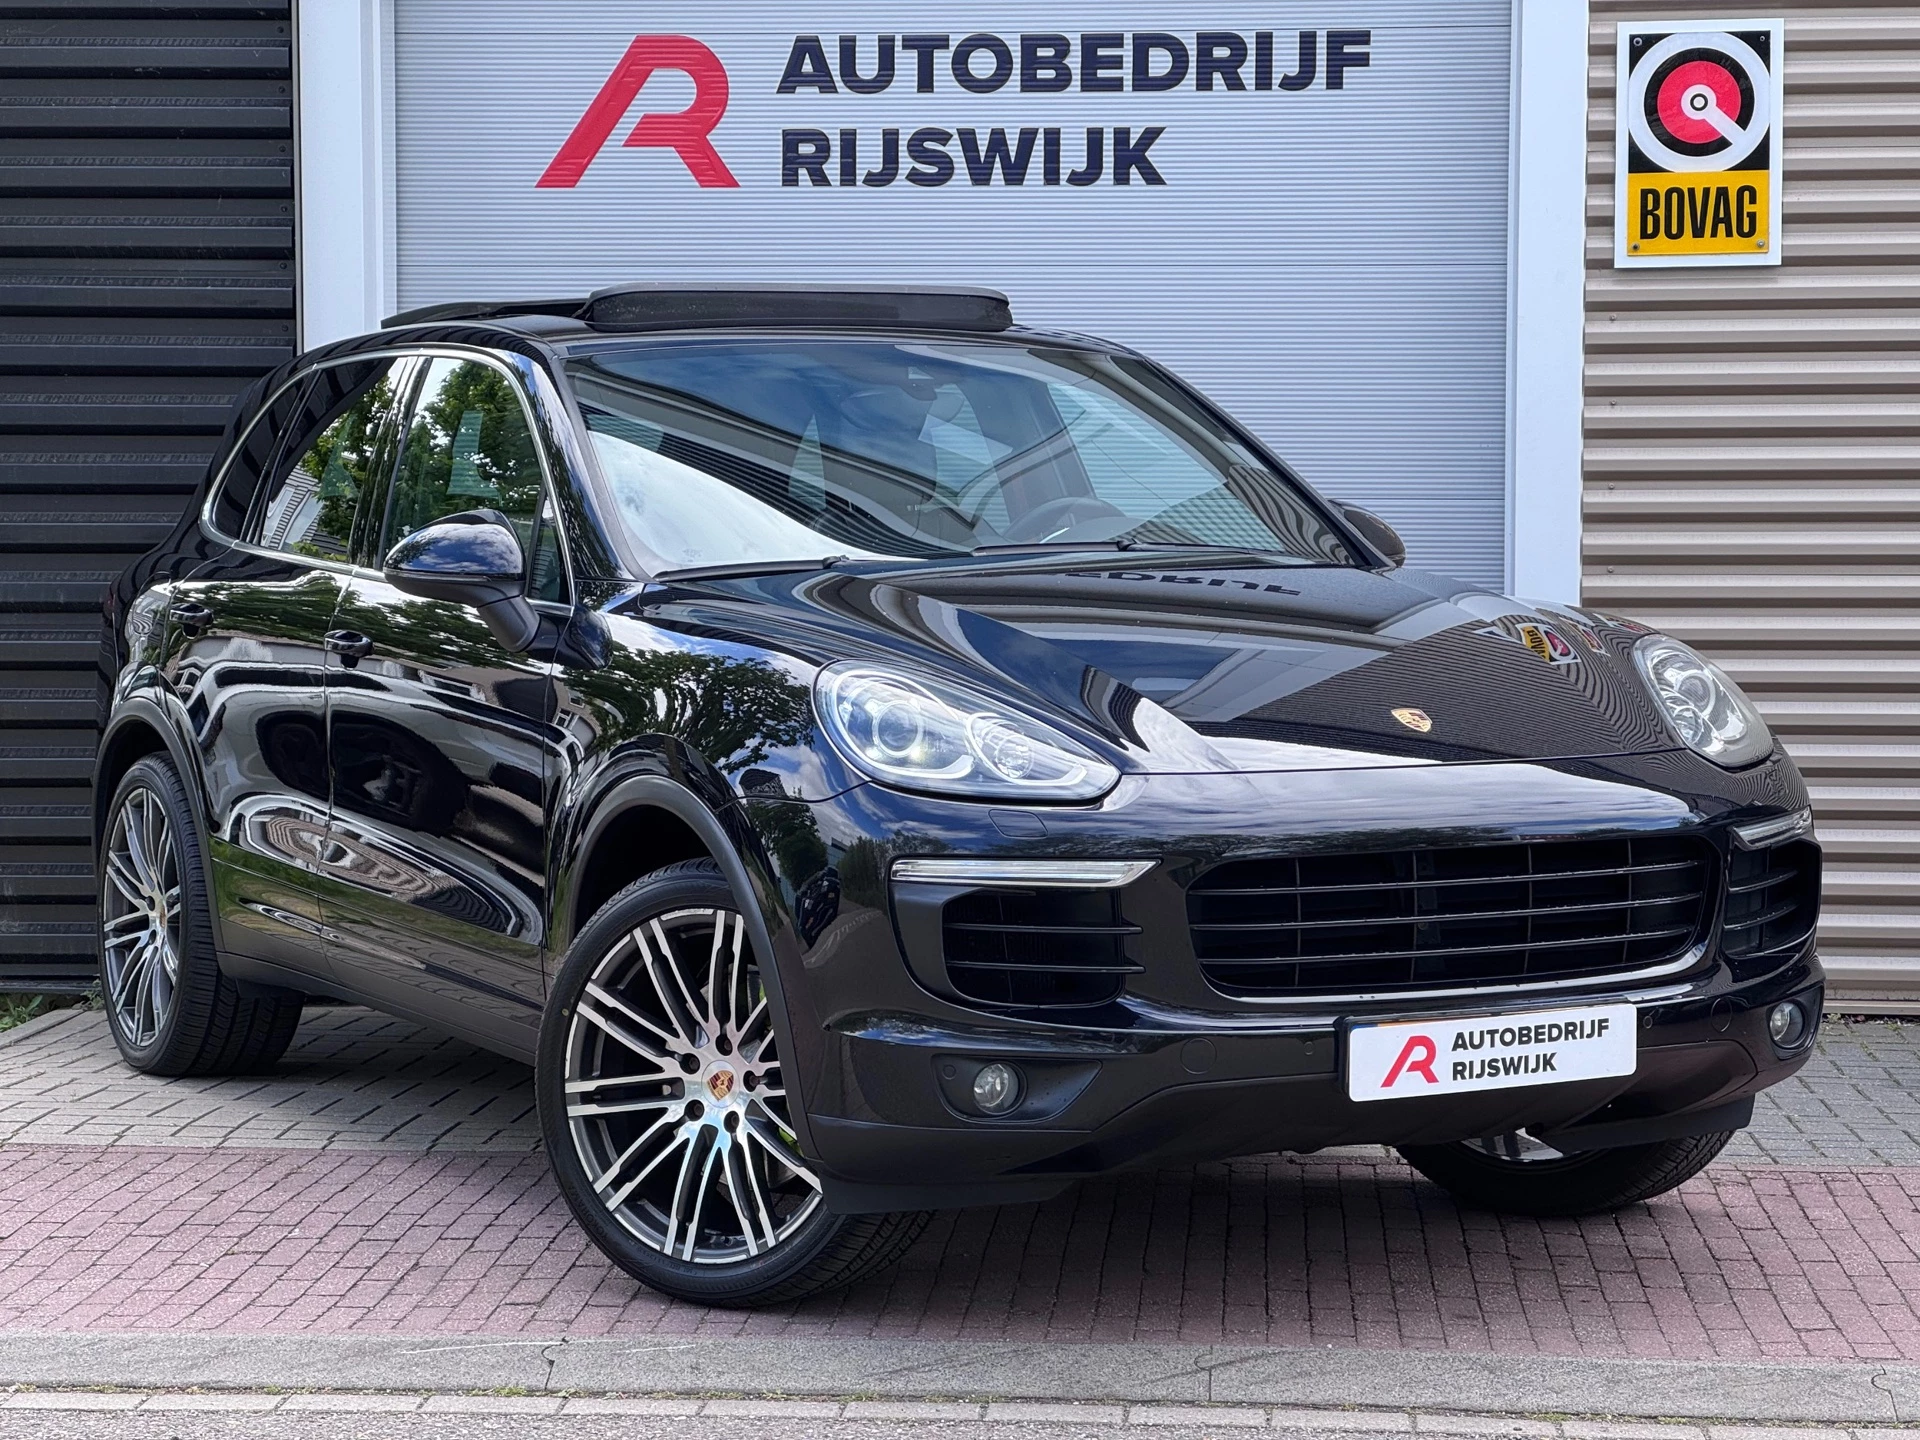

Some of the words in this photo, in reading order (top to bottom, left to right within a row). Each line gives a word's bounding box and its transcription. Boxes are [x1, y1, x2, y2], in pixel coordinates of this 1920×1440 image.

[777, 29, 1371, 94] AUTOBEDRIJF
[780, 127, 1167, 187] RIJSWIJK
[1640, 185, 1757, 240] BOVAG
[1451, 1018, 1609, 1052] AUTOBEDRIJF
[1452, 1053, 1557, 1081] RIJSWIJK
